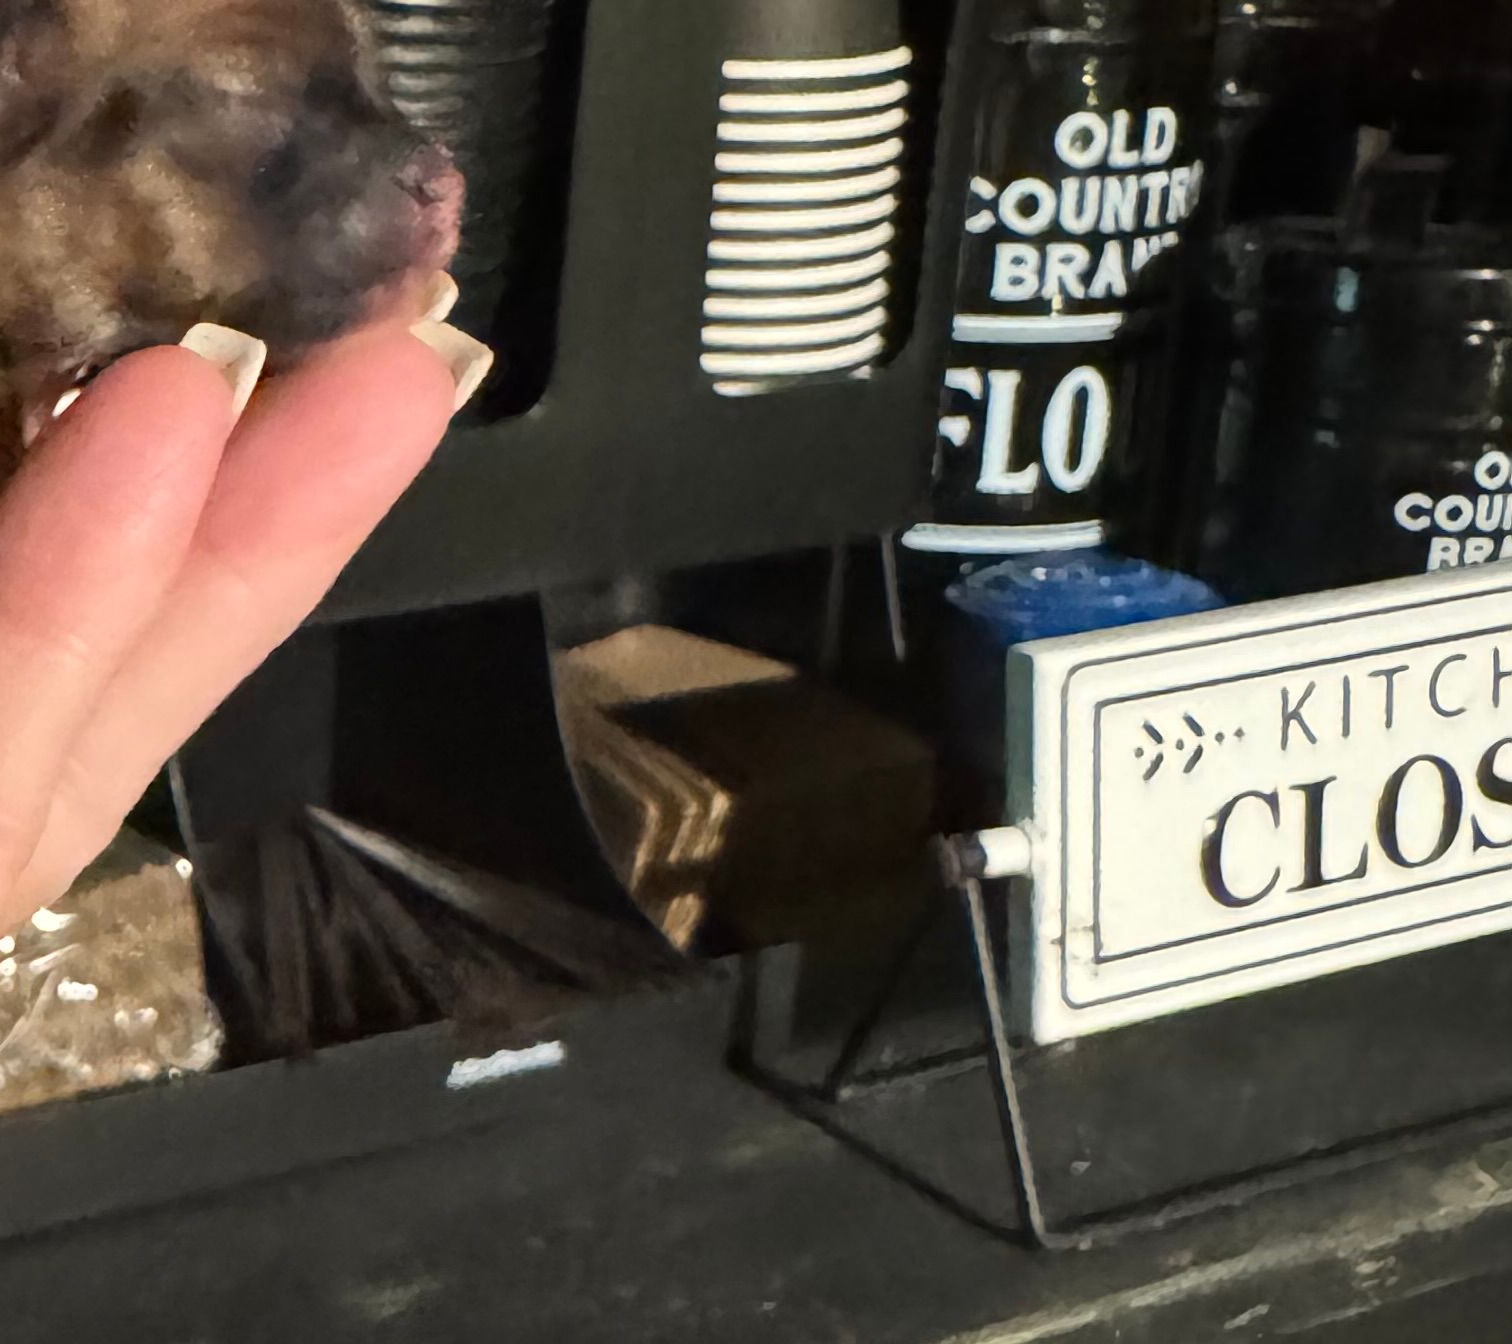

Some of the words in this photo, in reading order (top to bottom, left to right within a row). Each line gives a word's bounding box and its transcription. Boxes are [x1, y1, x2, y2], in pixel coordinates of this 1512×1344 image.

[1054, 106, 1178, 169] OLD
[990, 231, 1180, 301] BRA
[1393, 492, 1512, 533] COU
